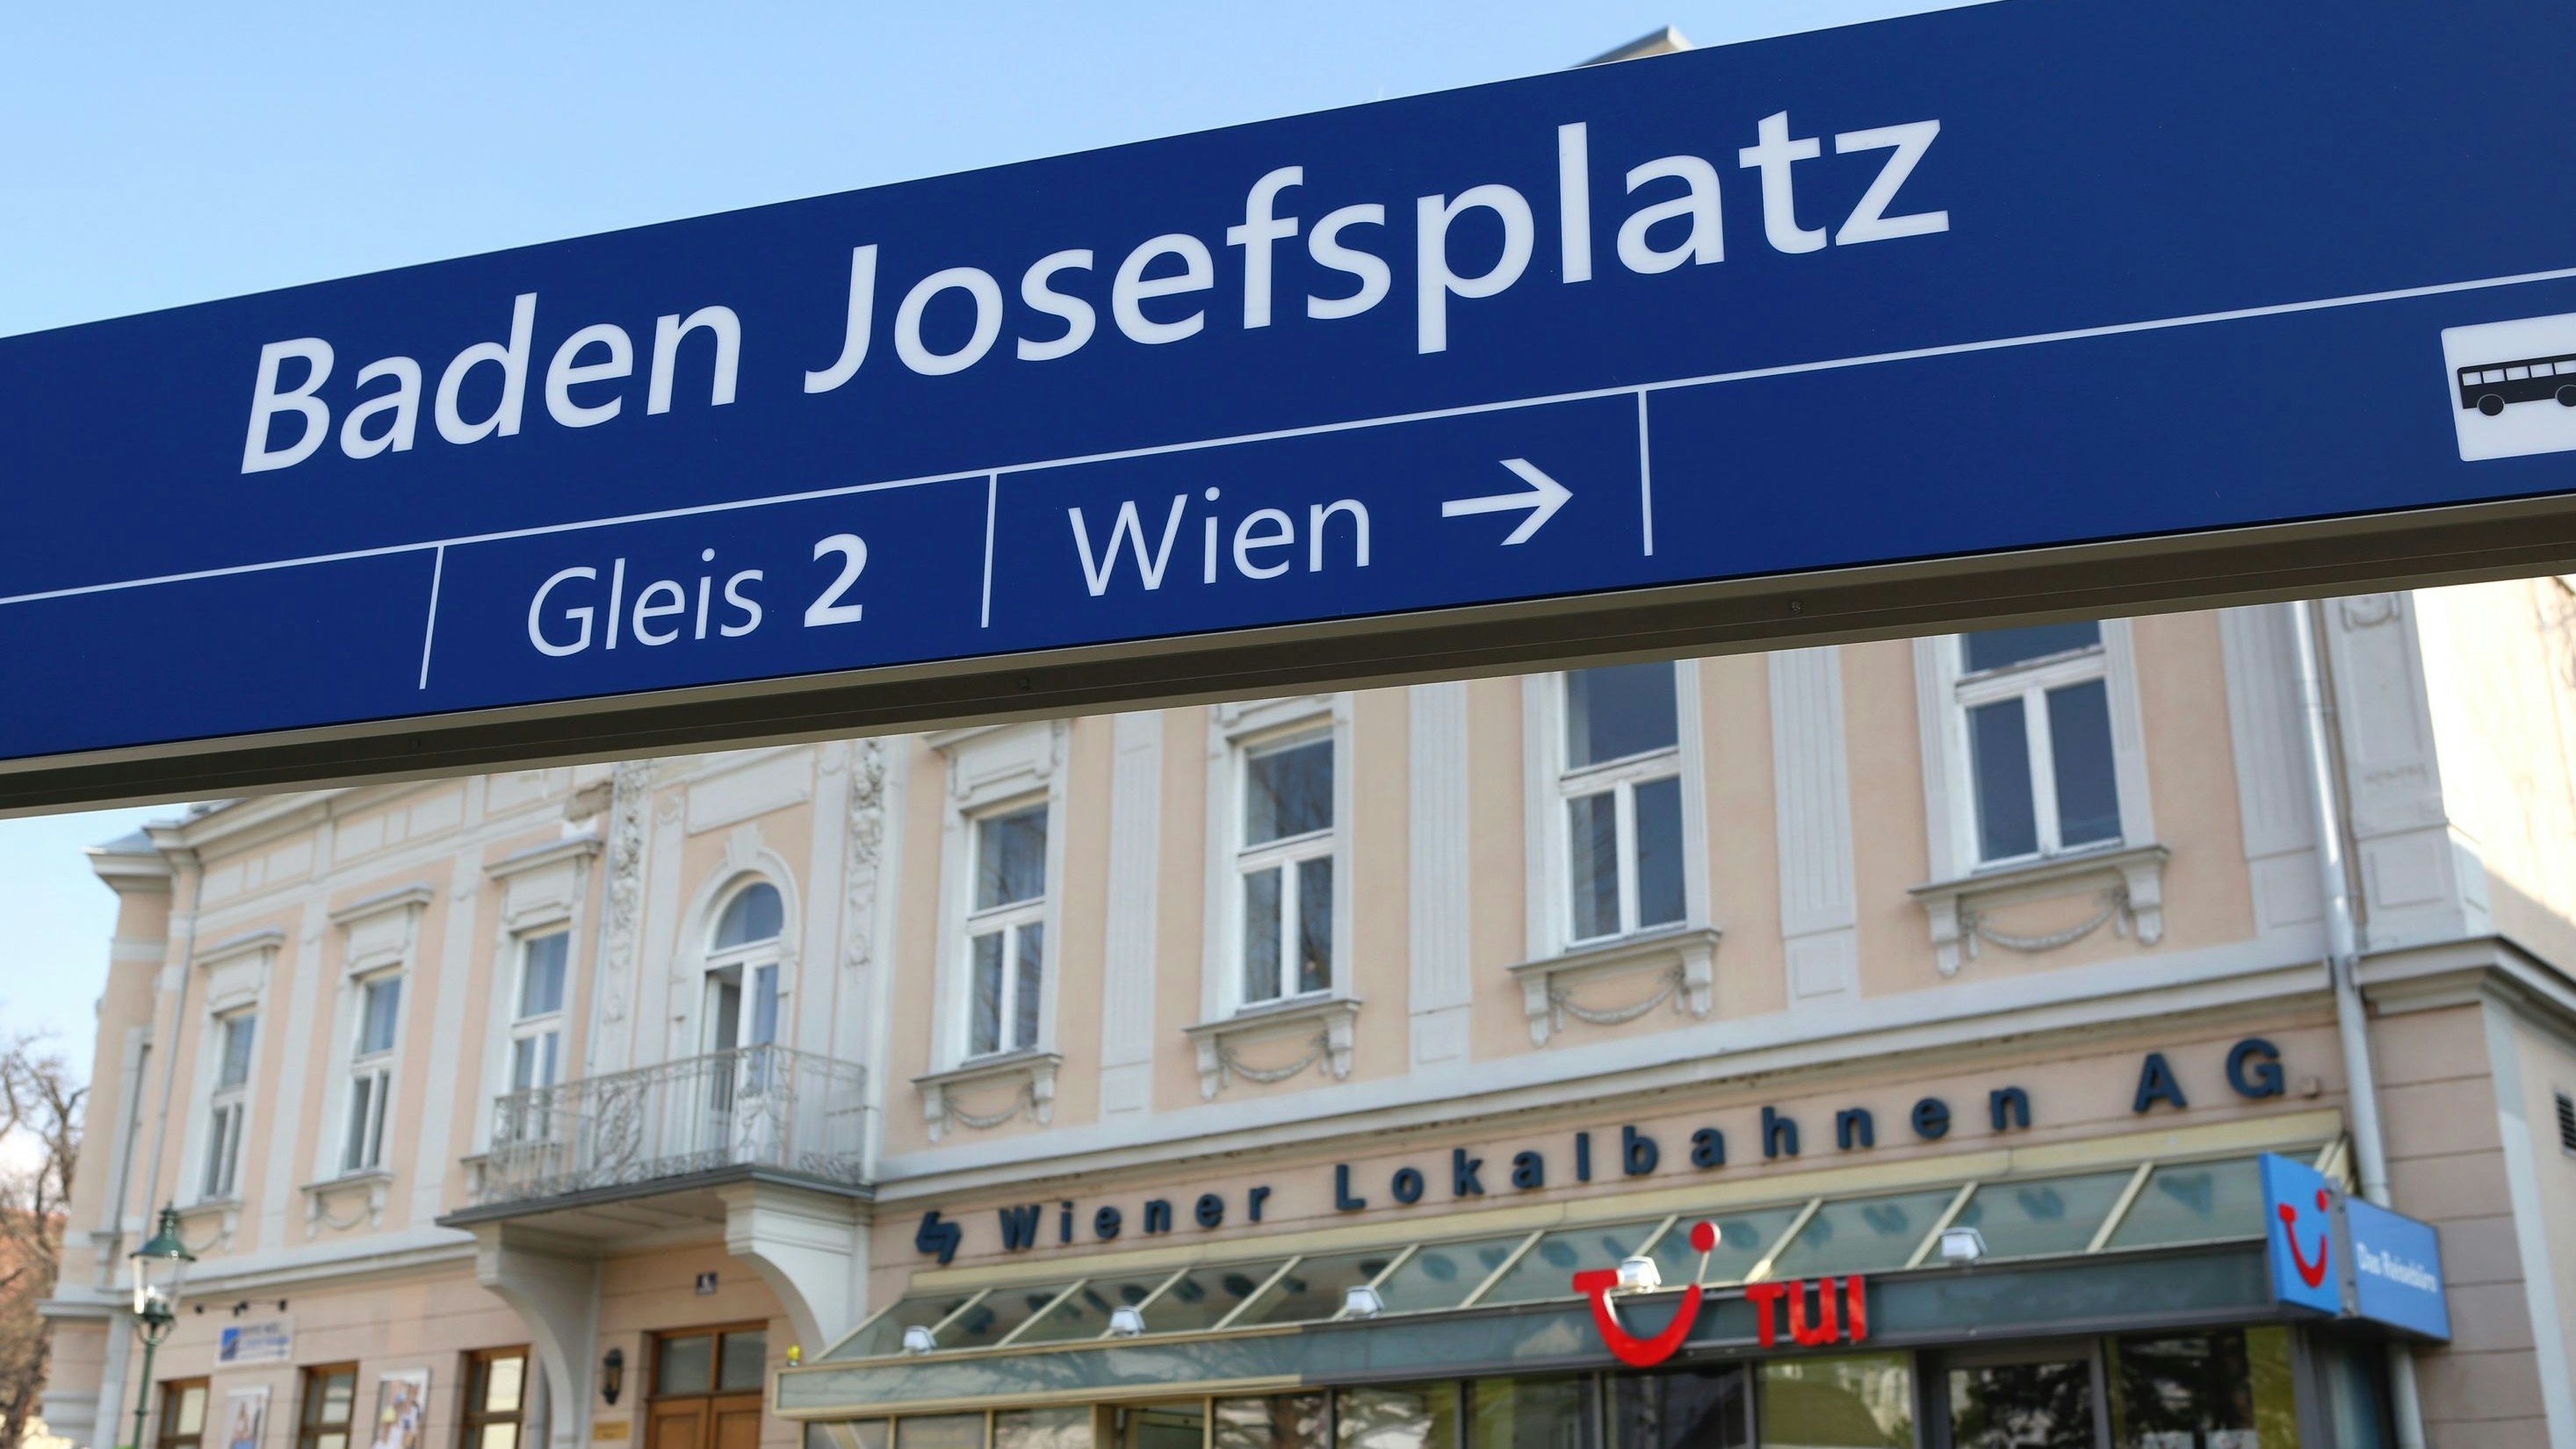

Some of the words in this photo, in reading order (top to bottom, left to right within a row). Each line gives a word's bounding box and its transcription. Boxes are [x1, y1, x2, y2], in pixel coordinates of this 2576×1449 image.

[241, 292, 741, 474] Baden
[804, 111, 1949, 393] Josefsplatz
[528, 548, 763, 657] Gleis
[804, 533, 868, 628] 2
[1068, 485, 1369, 596] Wien
[996, 1186, 1273, 1255] Wiener
[1333, 1085, 2033, 1217] Lokalbahnen
[2134, 1038, 2285, 1114] AG
[1744, 1273, 1867, 1349] TUI
